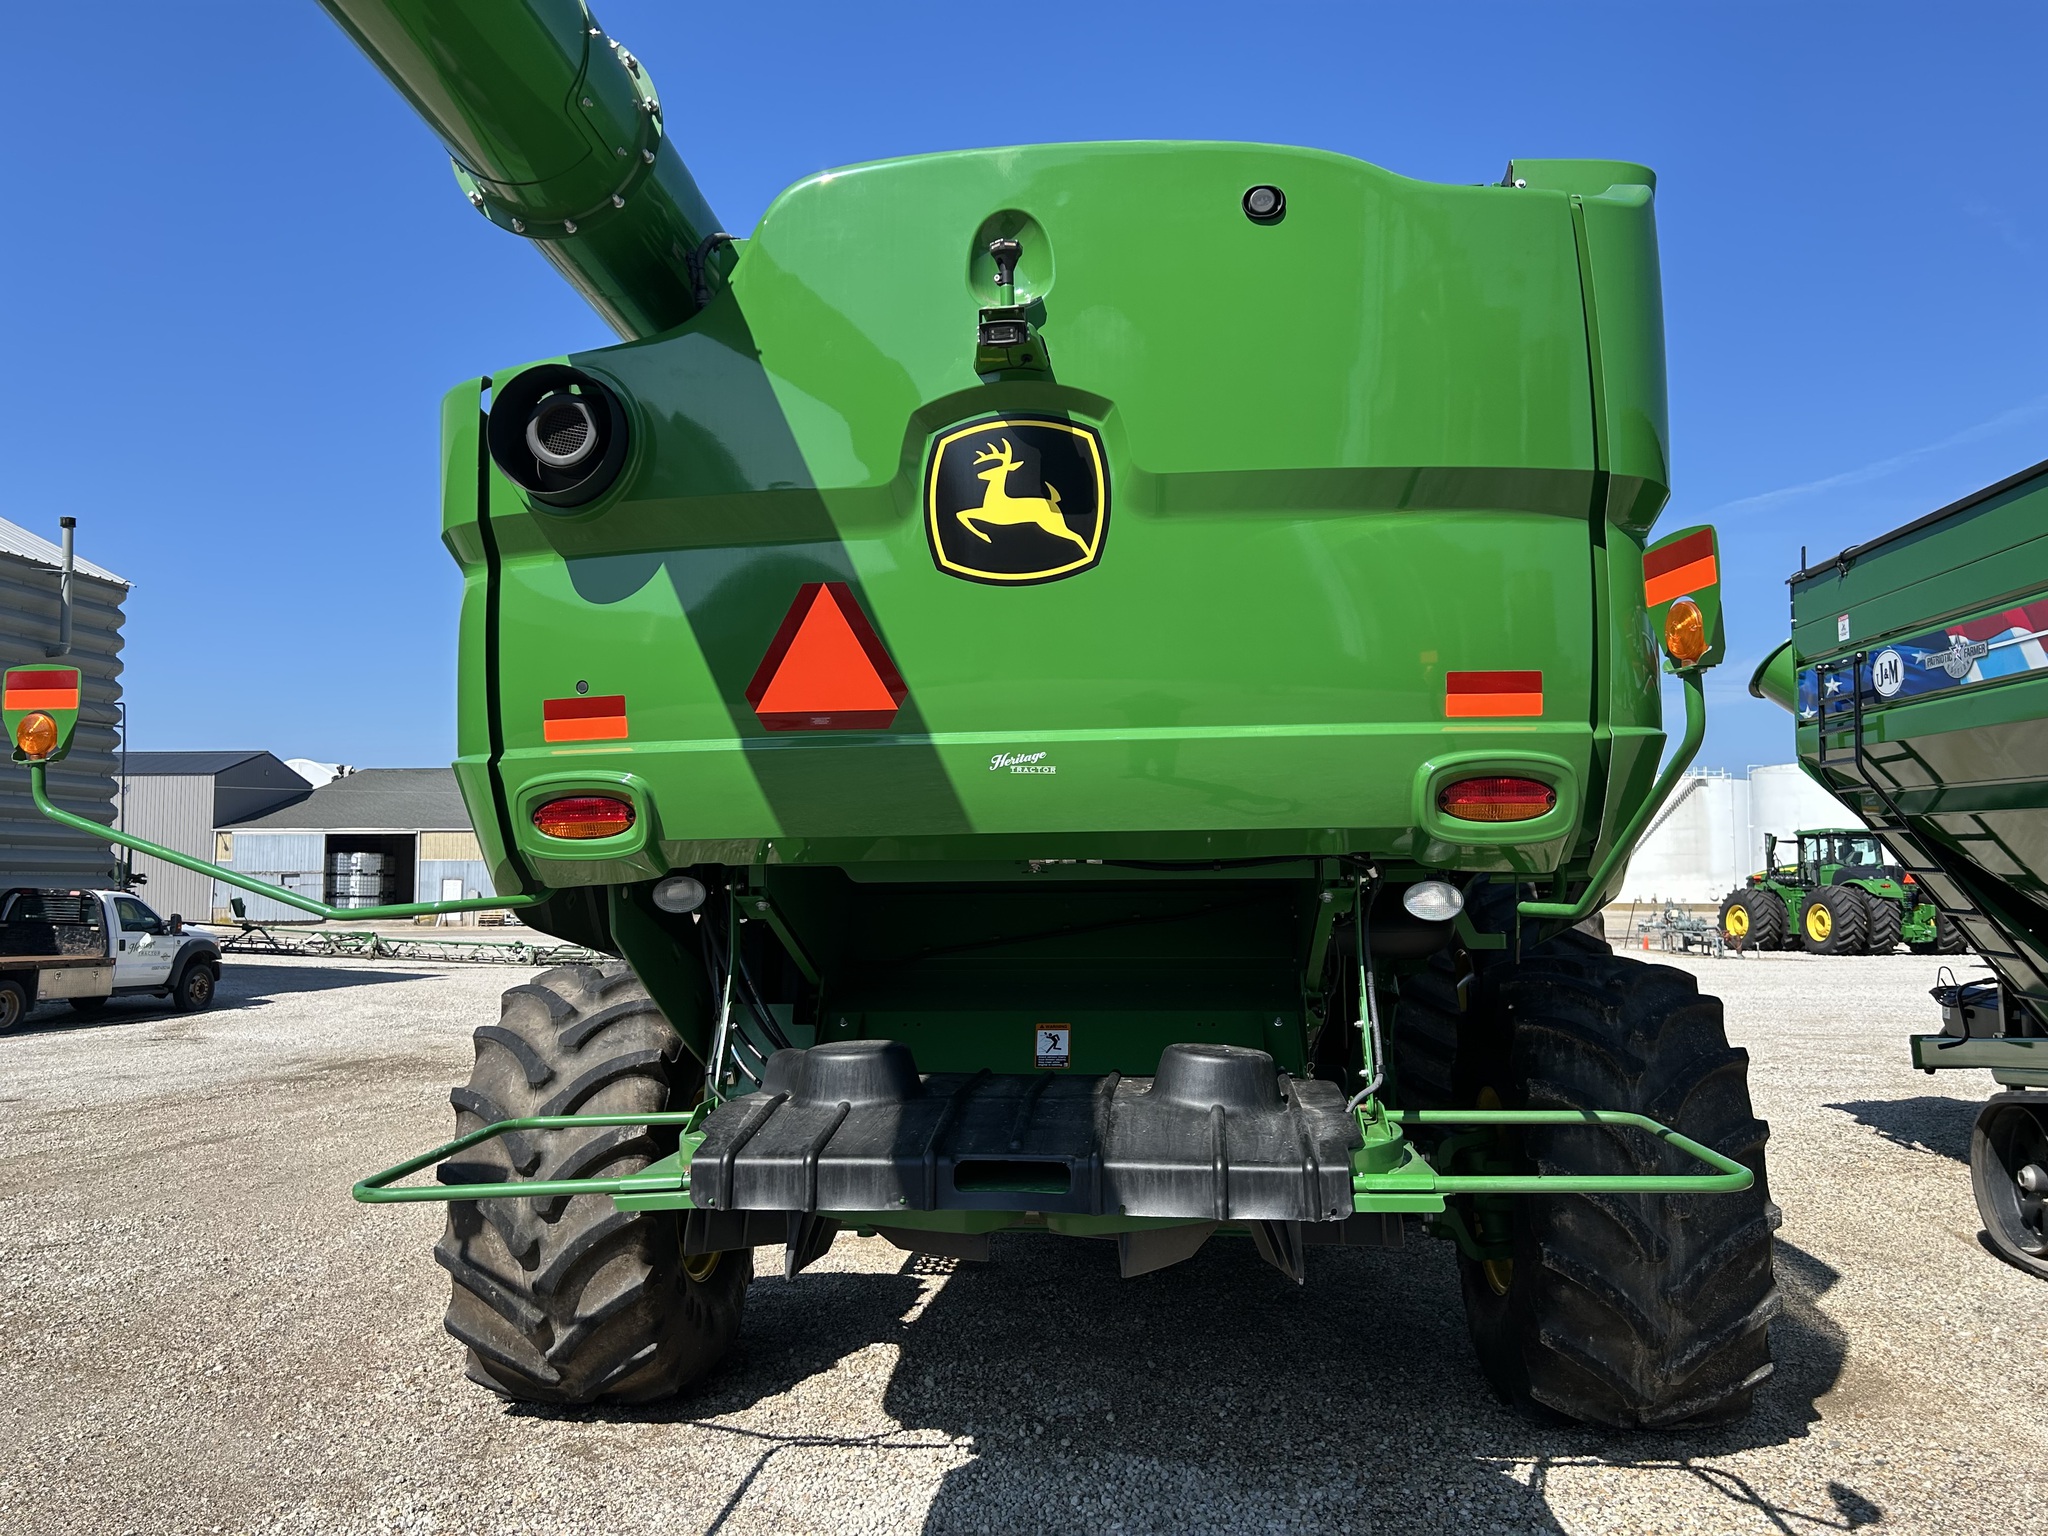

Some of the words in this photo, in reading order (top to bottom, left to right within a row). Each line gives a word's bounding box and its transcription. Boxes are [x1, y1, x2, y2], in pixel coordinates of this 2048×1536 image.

[1926, 652, 1953, 668] PATRIOTIC
[1963, 643, 1986, 659] FARMER
[1876, 659, 1899, 687] J&M
[989, 751, 1047, 771] Heritage
[1010, 766, 1056, 774] TRACTOR
[128, 941, 156, 955] Hetage
